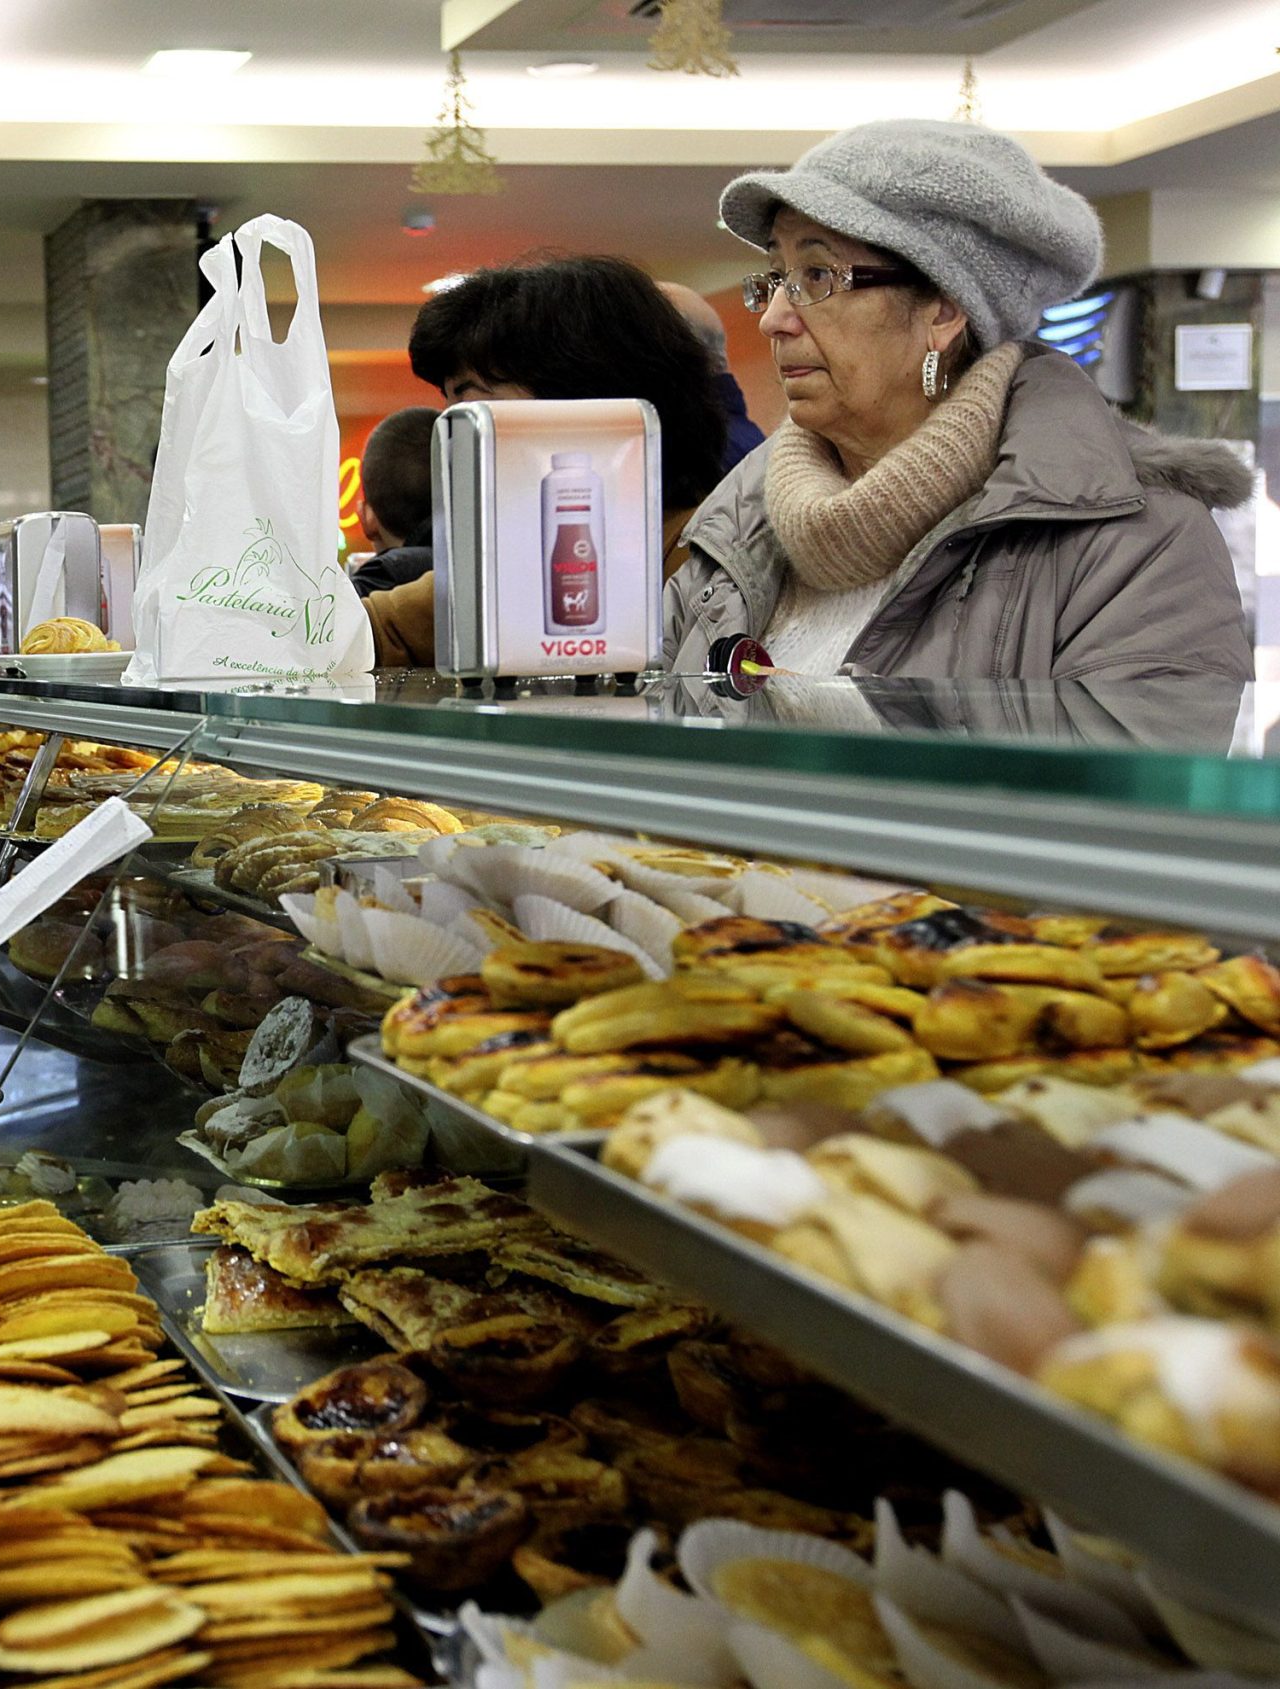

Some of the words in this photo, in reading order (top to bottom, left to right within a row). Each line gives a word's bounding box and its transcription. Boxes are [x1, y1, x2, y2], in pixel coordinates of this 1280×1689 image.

[176, 566, 297, 619] Pastelaria
[541, 640, 607, 656] VIGOR
[212, 656, 229, 668] A
[230, 661, 283, 676] excelência
[286, 667, 298, 677] da
